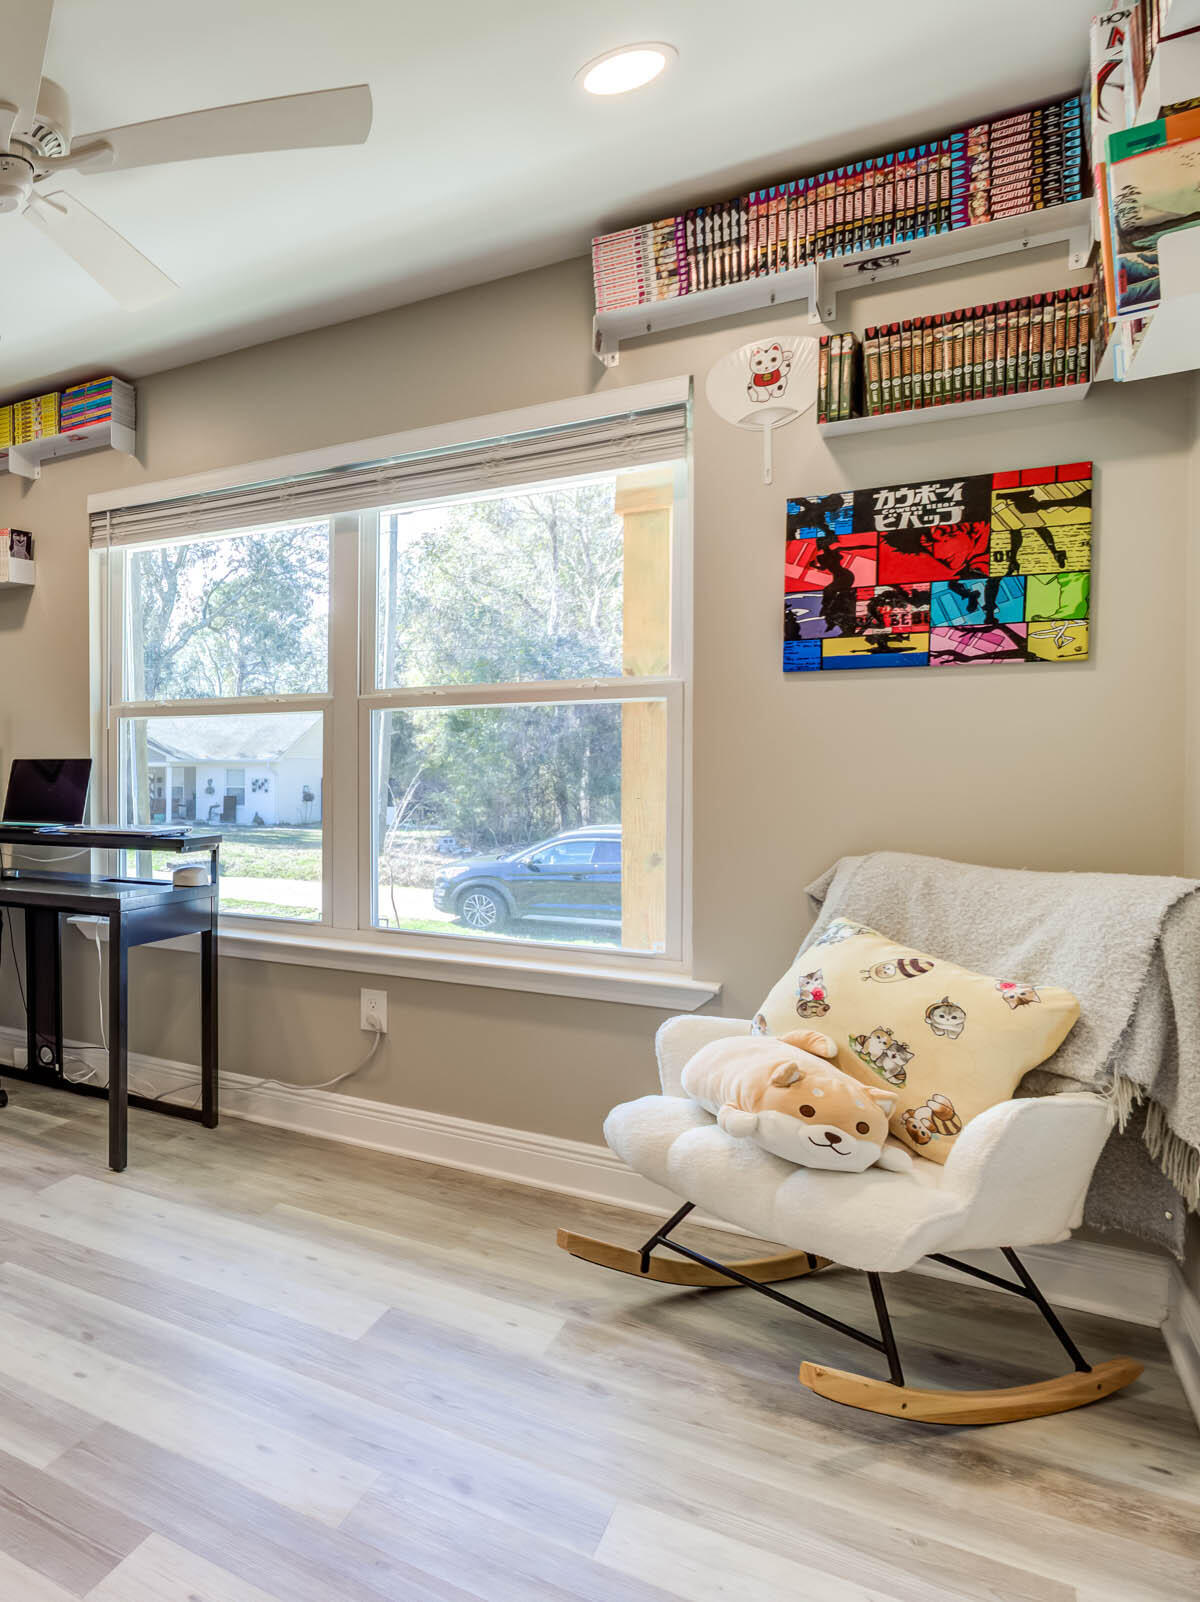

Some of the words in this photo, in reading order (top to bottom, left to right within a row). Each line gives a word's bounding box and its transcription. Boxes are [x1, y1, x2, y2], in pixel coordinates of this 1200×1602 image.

[872, 481, 966, 511] カウボーイ
[873, 505, 966, 532] ビバップ
